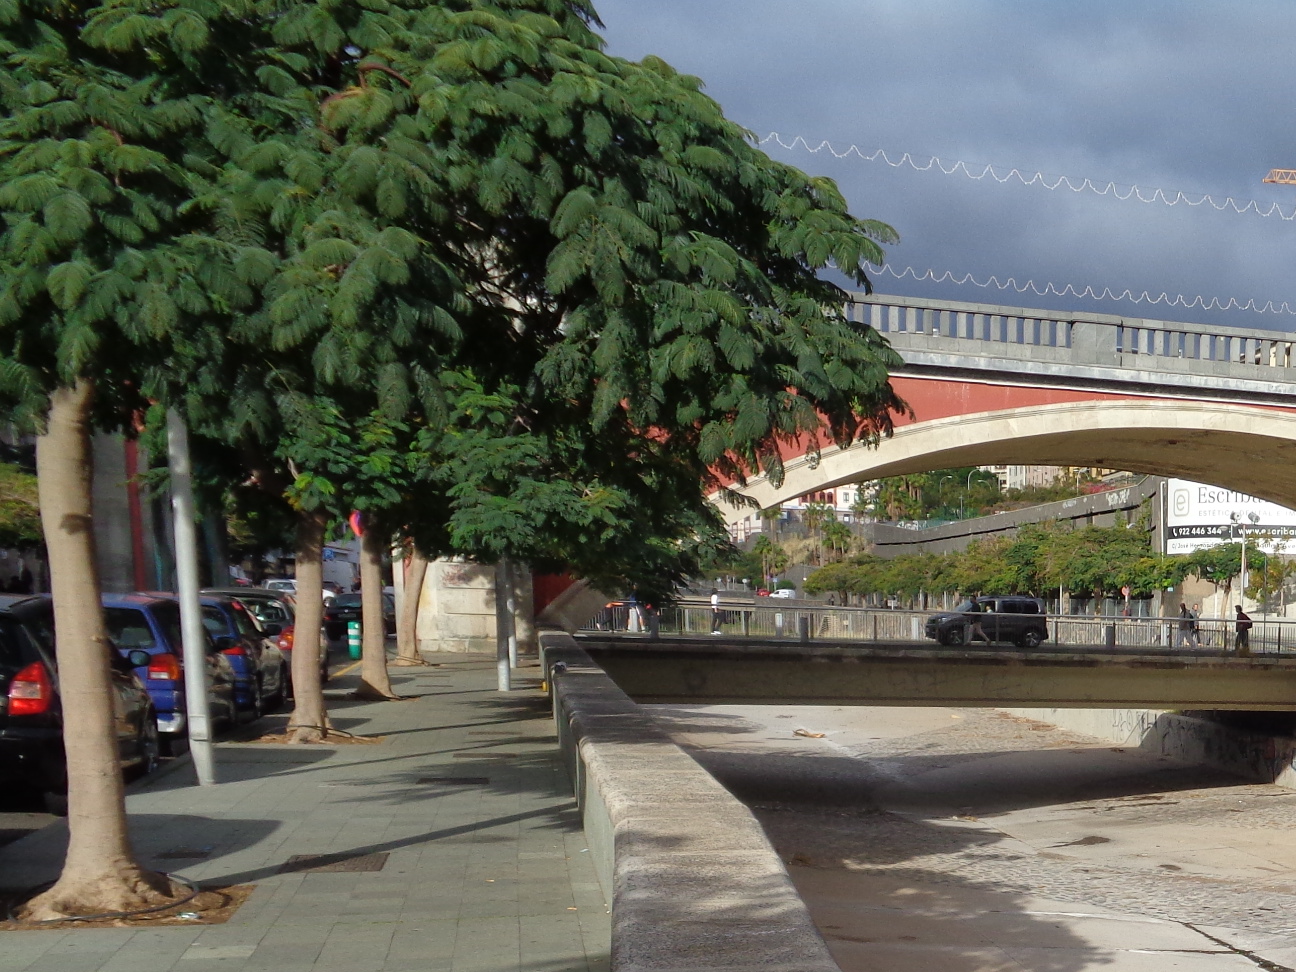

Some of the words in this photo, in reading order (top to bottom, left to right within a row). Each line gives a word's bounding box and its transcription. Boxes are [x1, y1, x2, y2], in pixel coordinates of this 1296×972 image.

[1198, 508, 1233, 517] ESTÉTIC
[1178, 526, 1190, 536] 922
[1191, 526, 1205, 535] 446
[1206, 526, 1222, 535] 344
